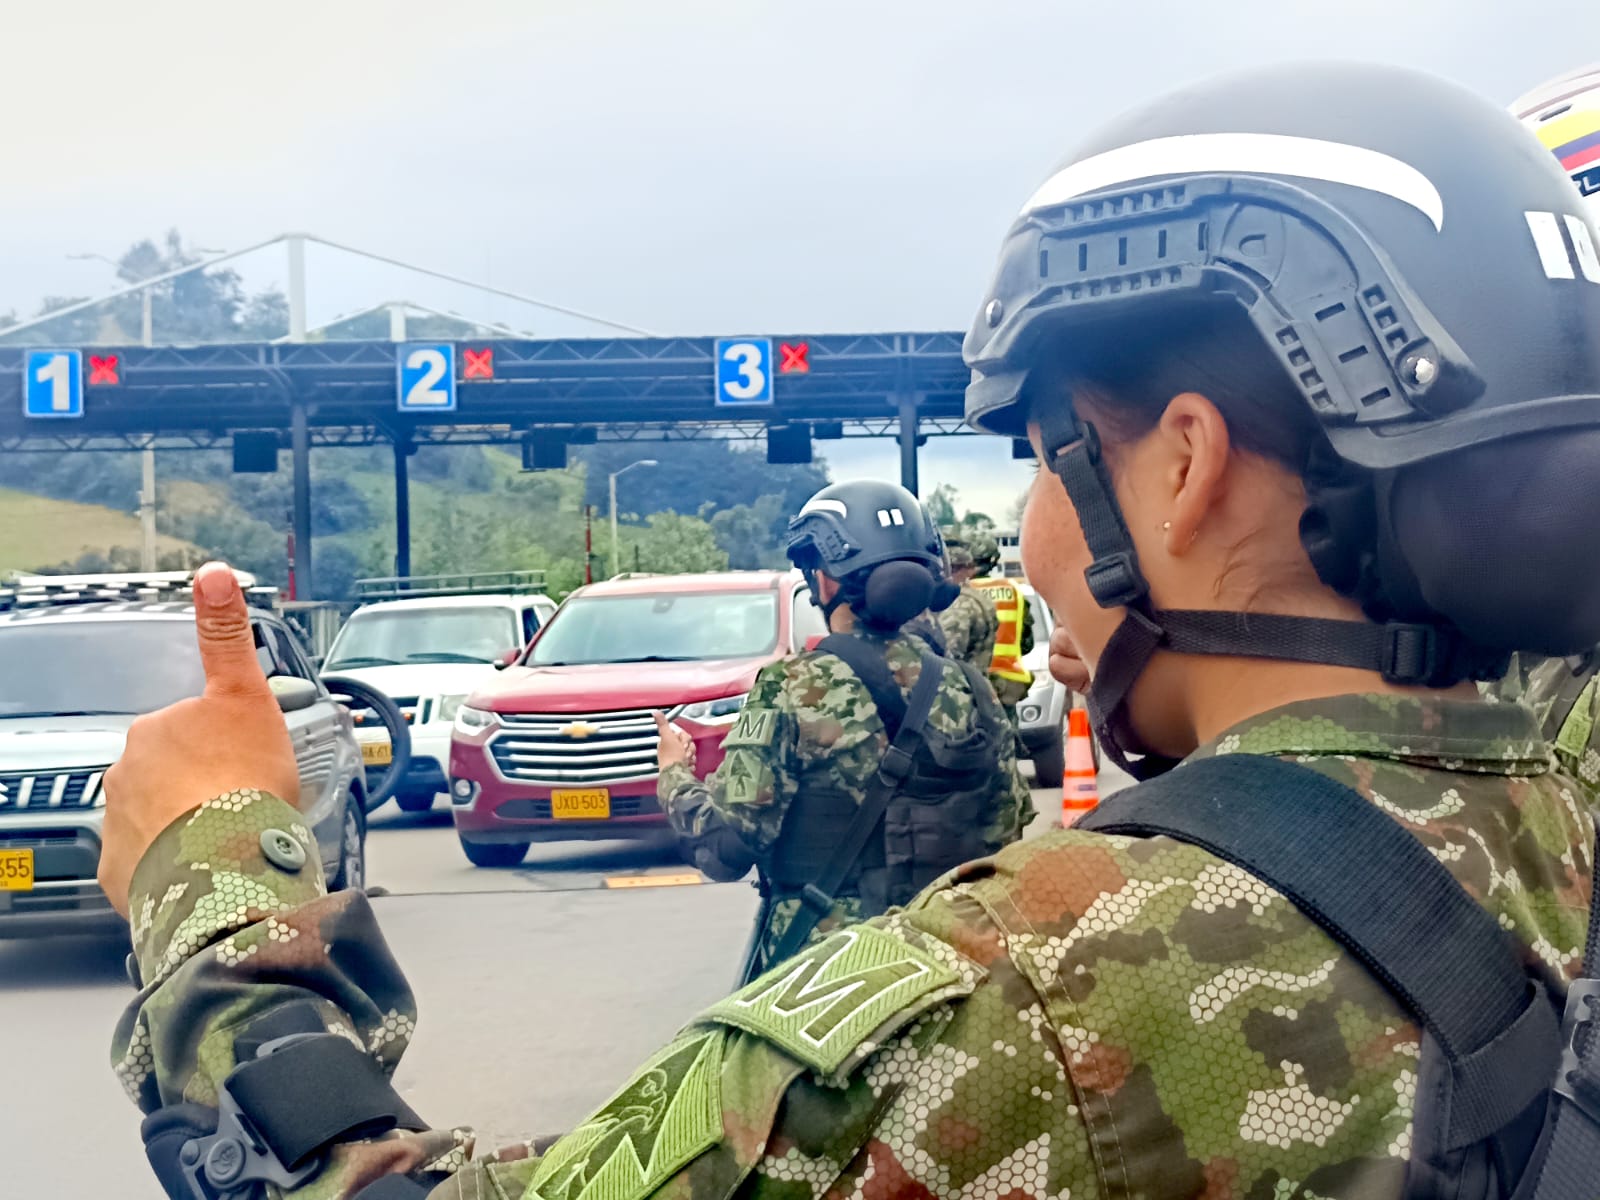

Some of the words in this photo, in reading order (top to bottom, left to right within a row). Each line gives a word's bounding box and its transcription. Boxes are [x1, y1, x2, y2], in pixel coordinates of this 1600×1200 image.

[37, 355, 70, 411] 1
[406, 349, 448, 404] 2
[722, 343, 766, 399] 3
[582, 794, 607, 809] 503
